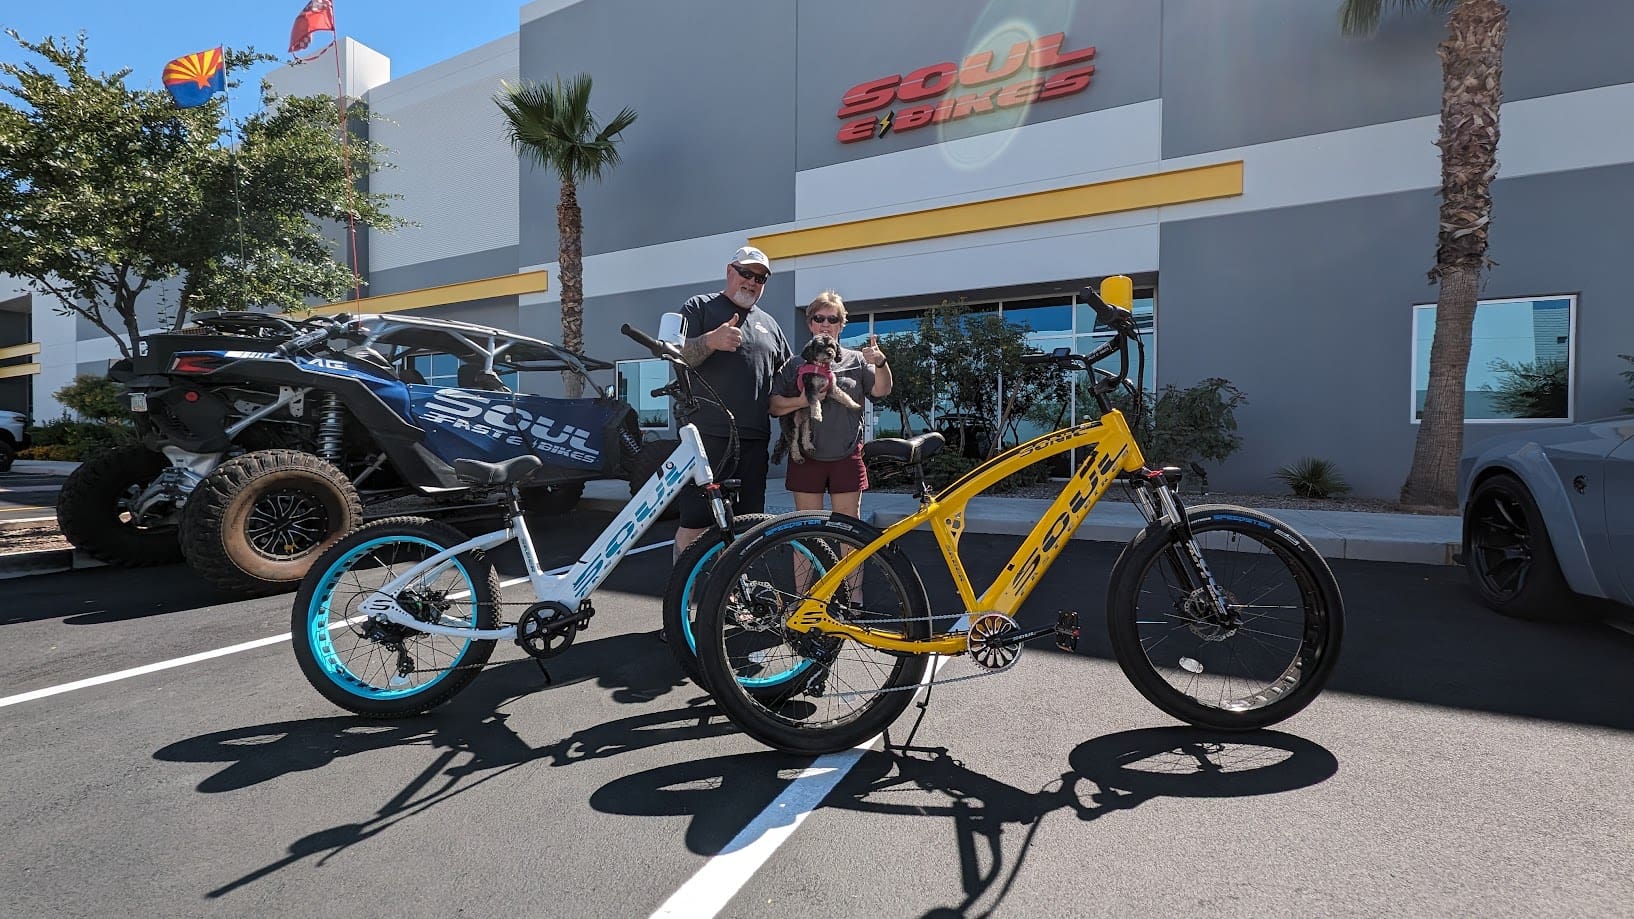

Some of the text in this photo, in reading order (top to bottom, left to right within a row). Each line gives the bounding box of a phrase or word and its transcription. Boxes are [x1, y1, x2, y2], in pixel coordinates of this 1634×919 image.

[837, 31, 1096, 118] SOUL
[837, 65, 1096, 144] E BIKES
[418, 411, 508, 441] FAST
[536, 441, 597, 464] BIKES
[424, 388, 600, 456] SOUL
[573, 456, 696, 598] SOUL
[1013, 443, 1129, 597] SOUL
